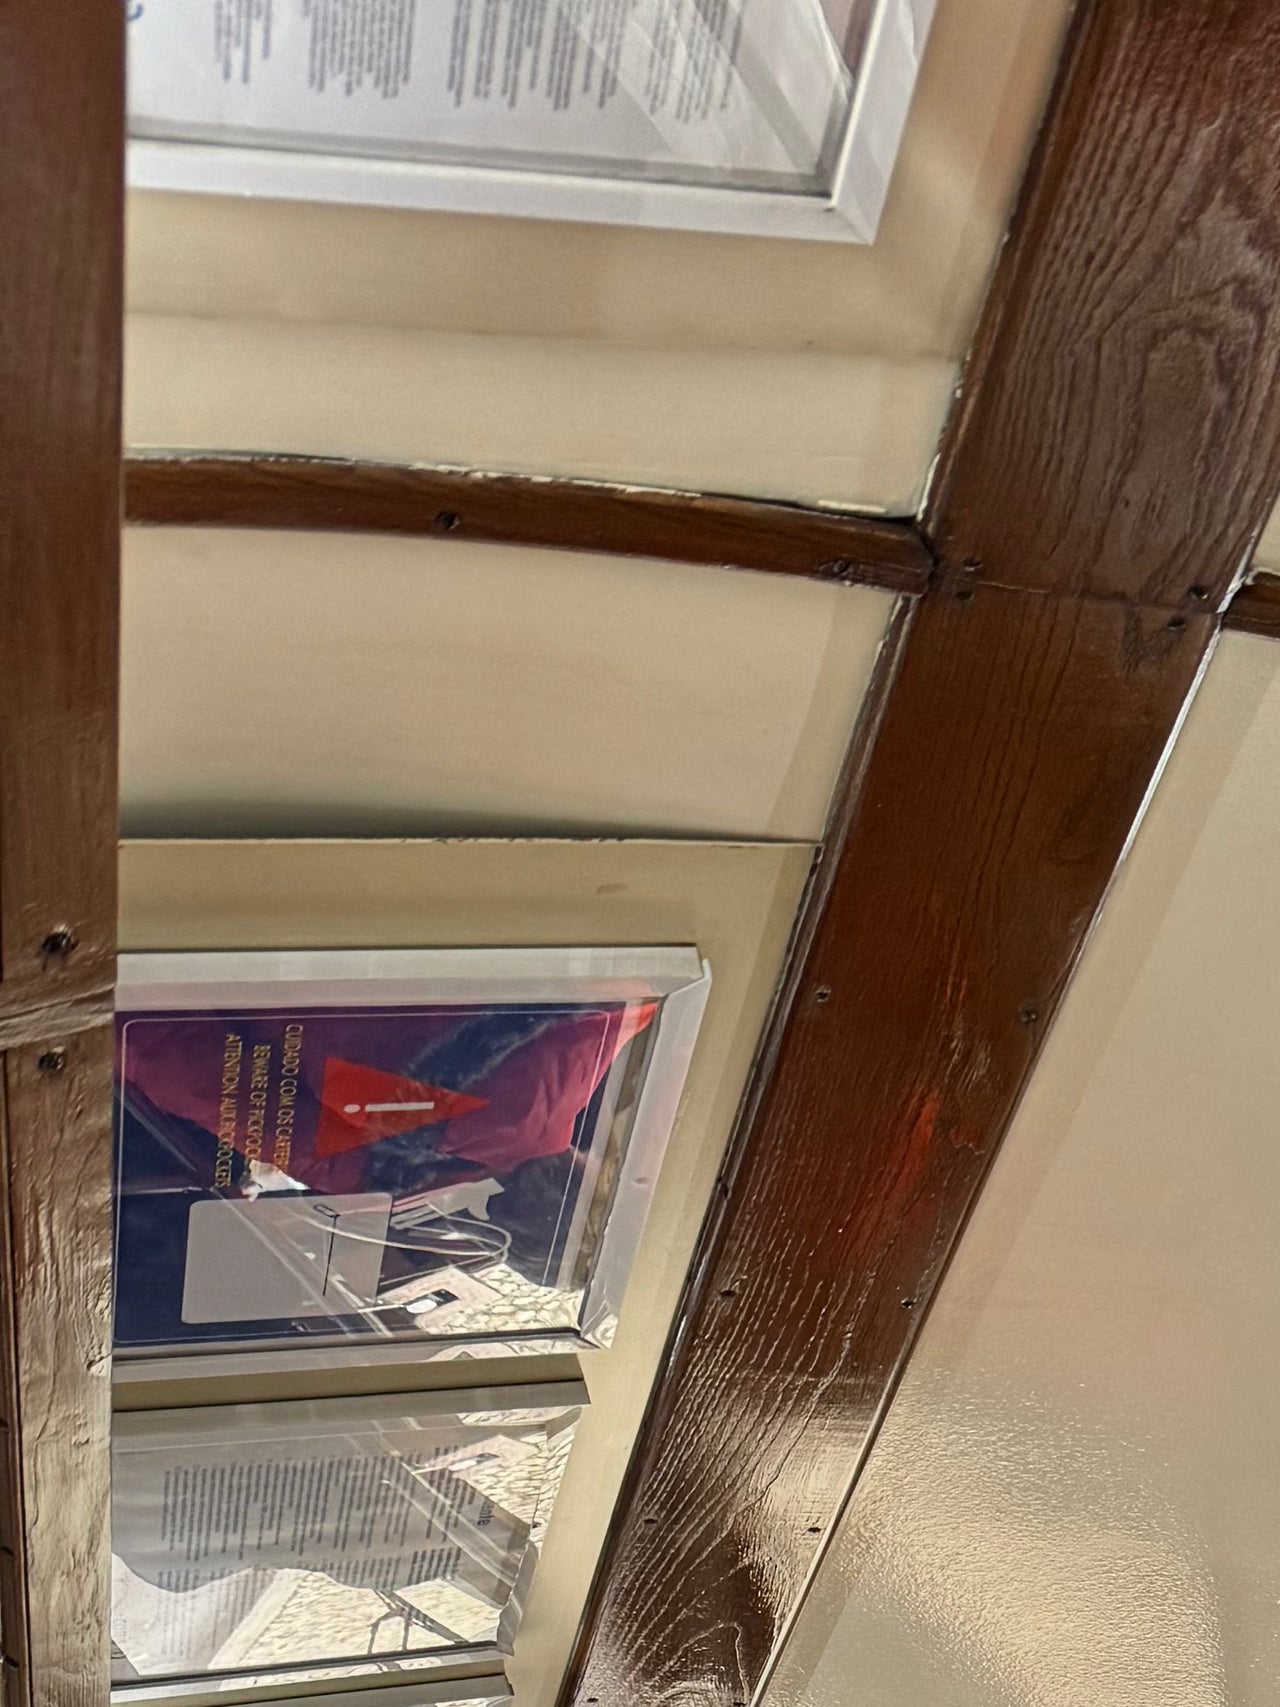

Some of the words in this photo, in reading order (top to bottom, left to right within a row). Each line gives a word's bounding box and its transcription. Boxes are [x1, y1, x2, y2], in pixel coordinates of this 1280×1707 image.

[221, 1033, 243, 1095] ATTENTION
[250, 1045, 271, 1090] BEWARE
[282, 1024, 303, 1076] CUIDADO
[249, 1091, 266, 1107] OF
[279, 1078, 297, 1107] COM
[277, 1109, 295, 1125] OS
